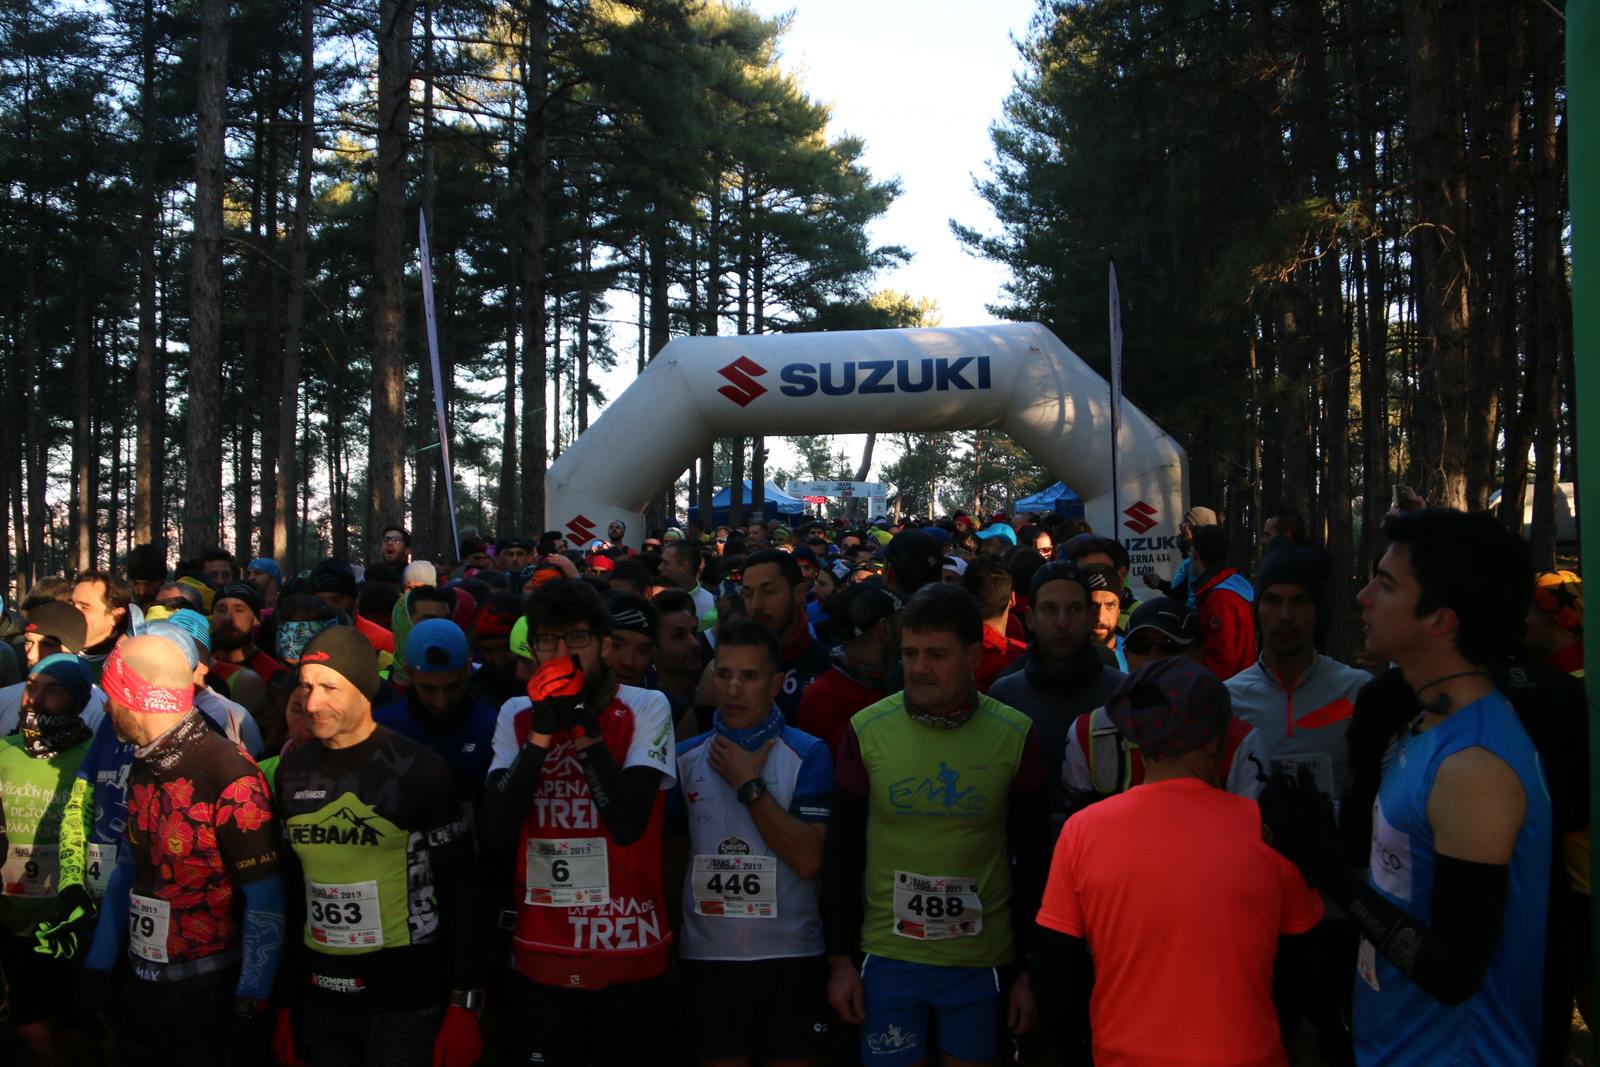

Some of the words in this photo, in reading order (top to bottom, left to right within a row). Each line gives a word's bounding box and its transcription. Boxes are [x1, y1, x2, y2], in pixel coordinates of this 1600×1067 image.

[780, 356, 991, 397] SUZUKI
[1156, 553, 1171, 562] 4X4
[1132, 564, 1154, 577] LEÓN
[783, 668, 797, 695] 6
[25, 860, 39, 878] 9
[551, 859, 570, 882] 6
[707, 873, 761, 896] 446
[311, 900, 362, 925] 363
[907, 894, 965, 918] 488
[567, 910, 662, 950] TREN
